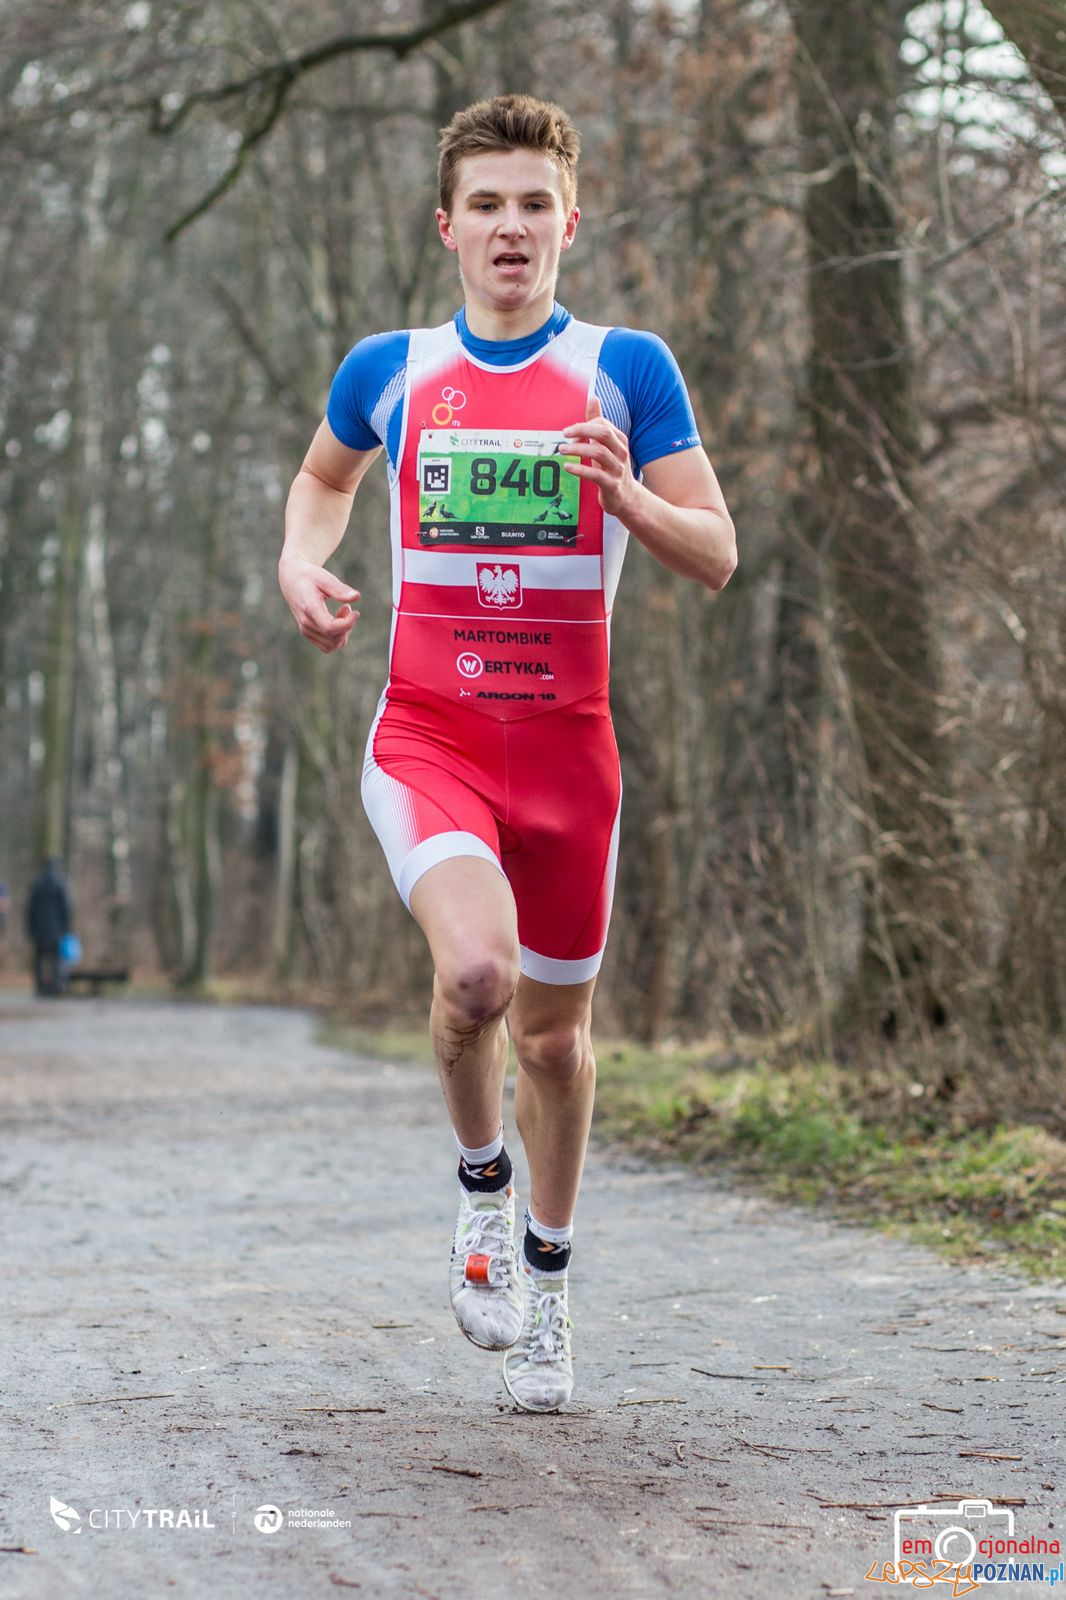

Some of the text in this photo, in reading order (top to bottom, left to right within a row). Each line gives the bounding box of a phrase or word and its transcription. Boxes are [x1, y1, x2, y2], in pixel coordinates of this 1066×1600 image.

[470, 458, 560, 498] 840
[454, 629, 553, 645] MARTOMBIKE
[476, 690, 556, 701] ARGON 18
